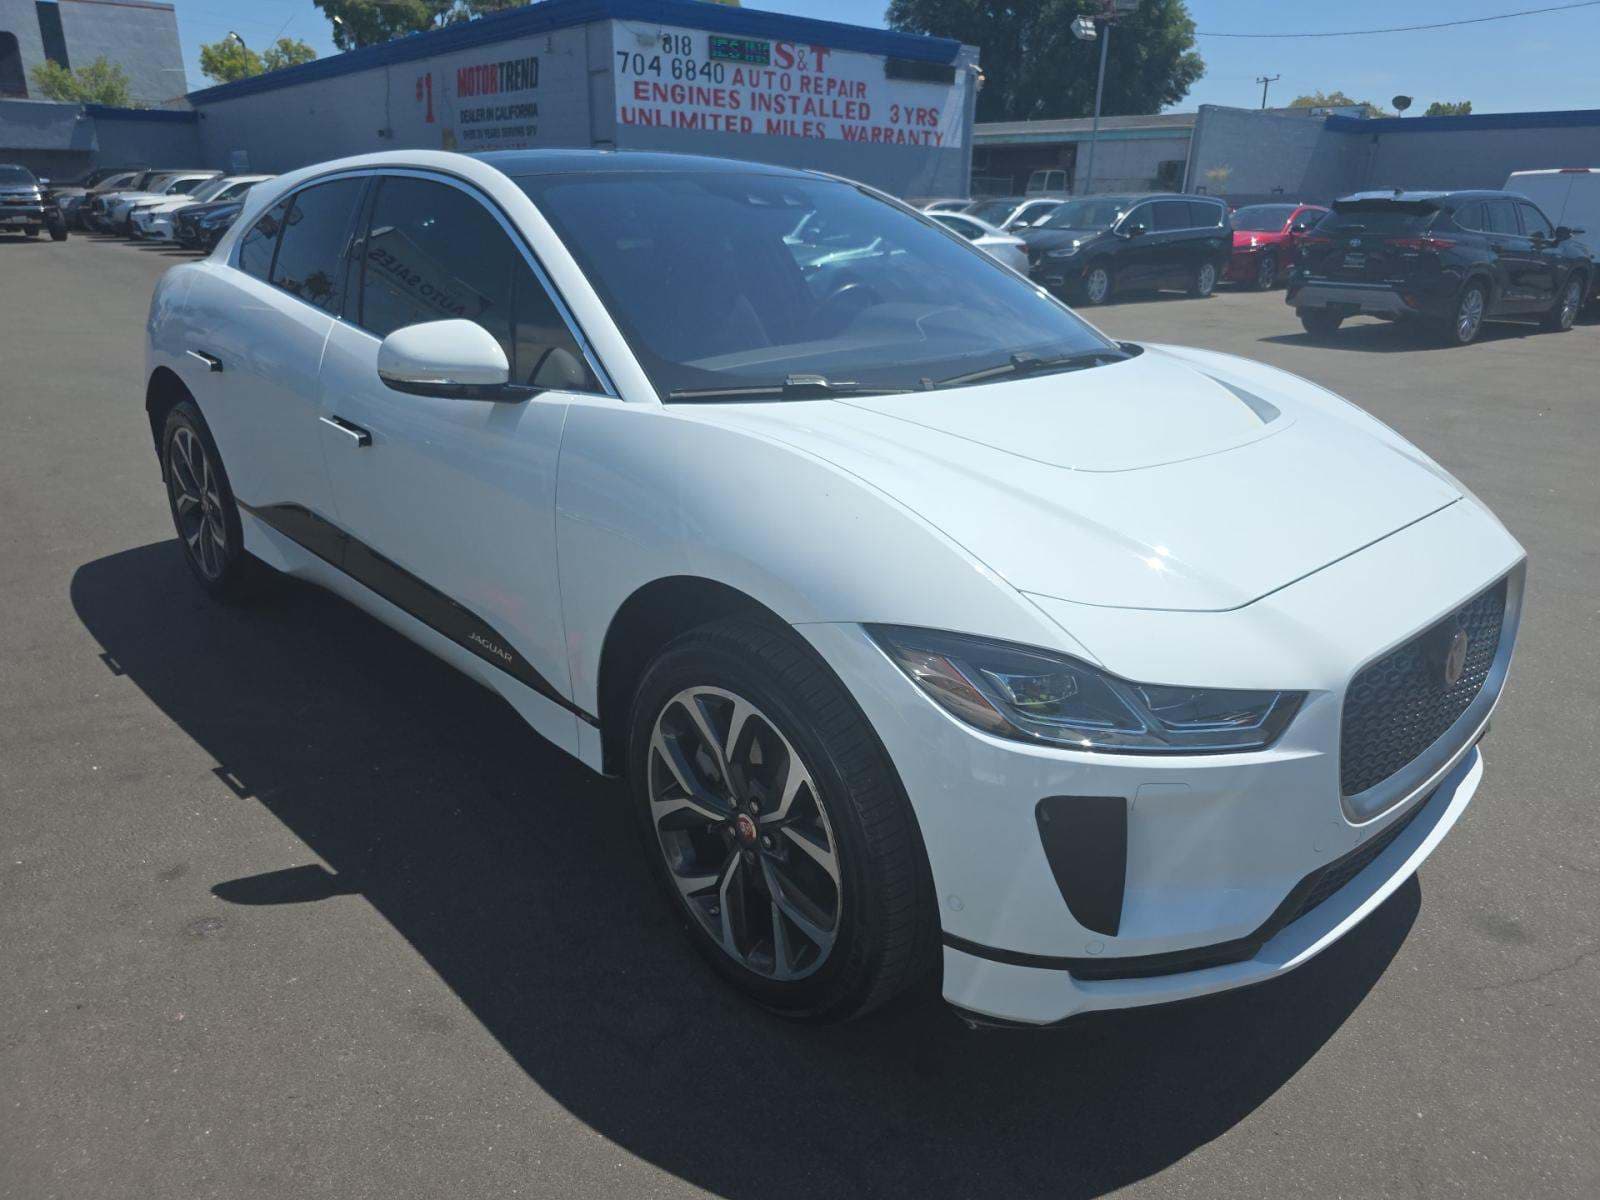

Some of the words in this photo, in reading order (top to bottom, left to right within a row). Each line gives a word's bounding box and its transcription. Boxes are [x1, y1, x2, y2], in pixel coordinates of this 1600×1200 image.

[662, 33, 692, 56] 818
[616, 51, 661, 77] 704
[671, 58, 725, 84] 6840
[732, 68, 792, 92] AUTO
[800, 75, 867, 99] REPAIR
[634, 80, 741, 110] ENGINES
[751, 92, 871, 121] INSTALLED
[889, 104, 900, 124] 3
[904, 107, 940, 127] YRS
[620, 106, 753, 134] UNLIMITED
[766, 118, 827, 140] MILES
[841, 124, 945, 147] WARRANTY
[468, 632, 512, 664] JAGUAR
